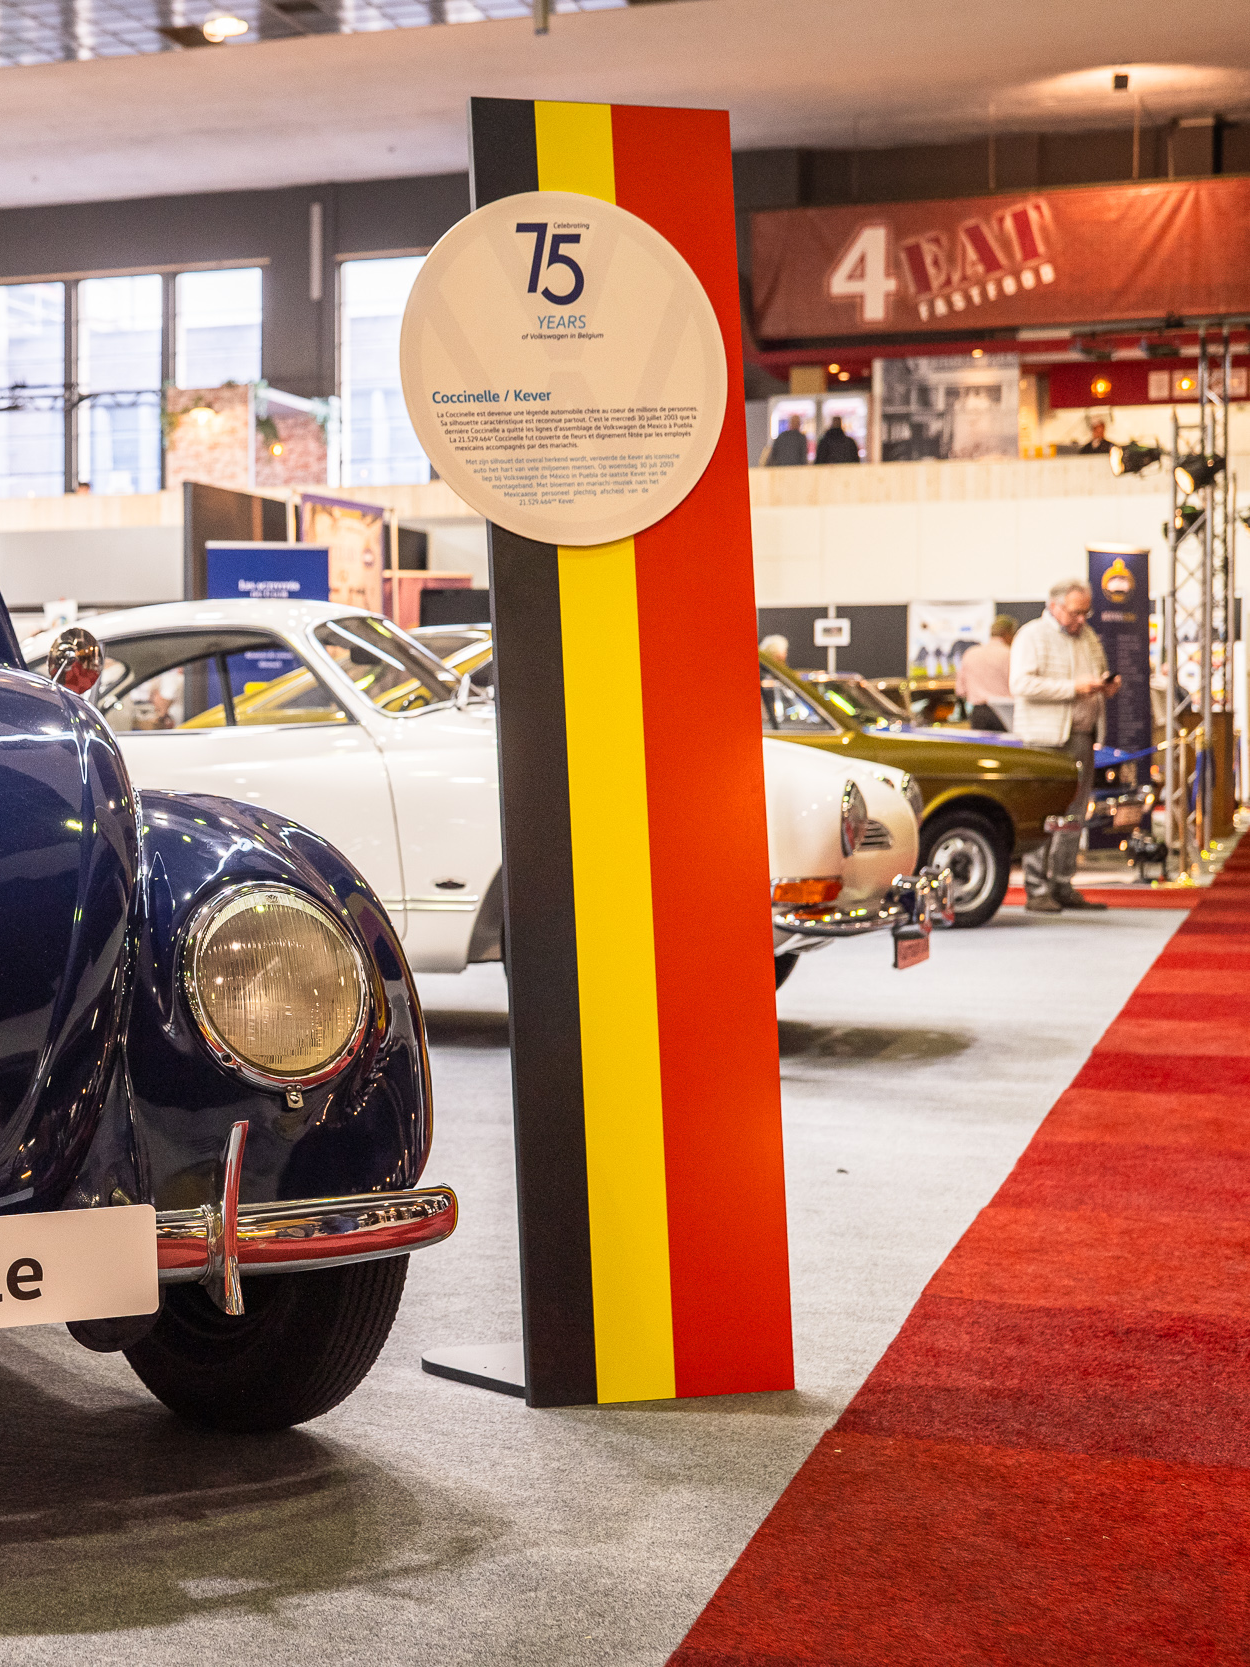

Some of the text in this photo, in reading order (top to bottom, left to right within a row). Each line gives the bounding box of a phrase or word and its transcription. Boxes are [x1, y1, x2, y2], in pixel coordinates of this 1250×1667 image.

[553, 221, 590, 230] Celebrating
[515, 222, 585, 306] 75
[830, 200, 1054, 322] 4 EAT
[537, 314, 587, 329] YEARS
[530, 332, 568, 341] Volkswagen
[578, 332, 604, 341] Belgium
[432, 389, 552, 404] Coccinelle / Kever
[526, 409, 549, 417] légende
[480, 418, 523, 427] caractéristique
[564, 416, 586, 424] partout.
[646, 414, 661, 422] juillet
[535, 425, 552, 433] lignes
[603, 423, 637, 431] Volkswagen
